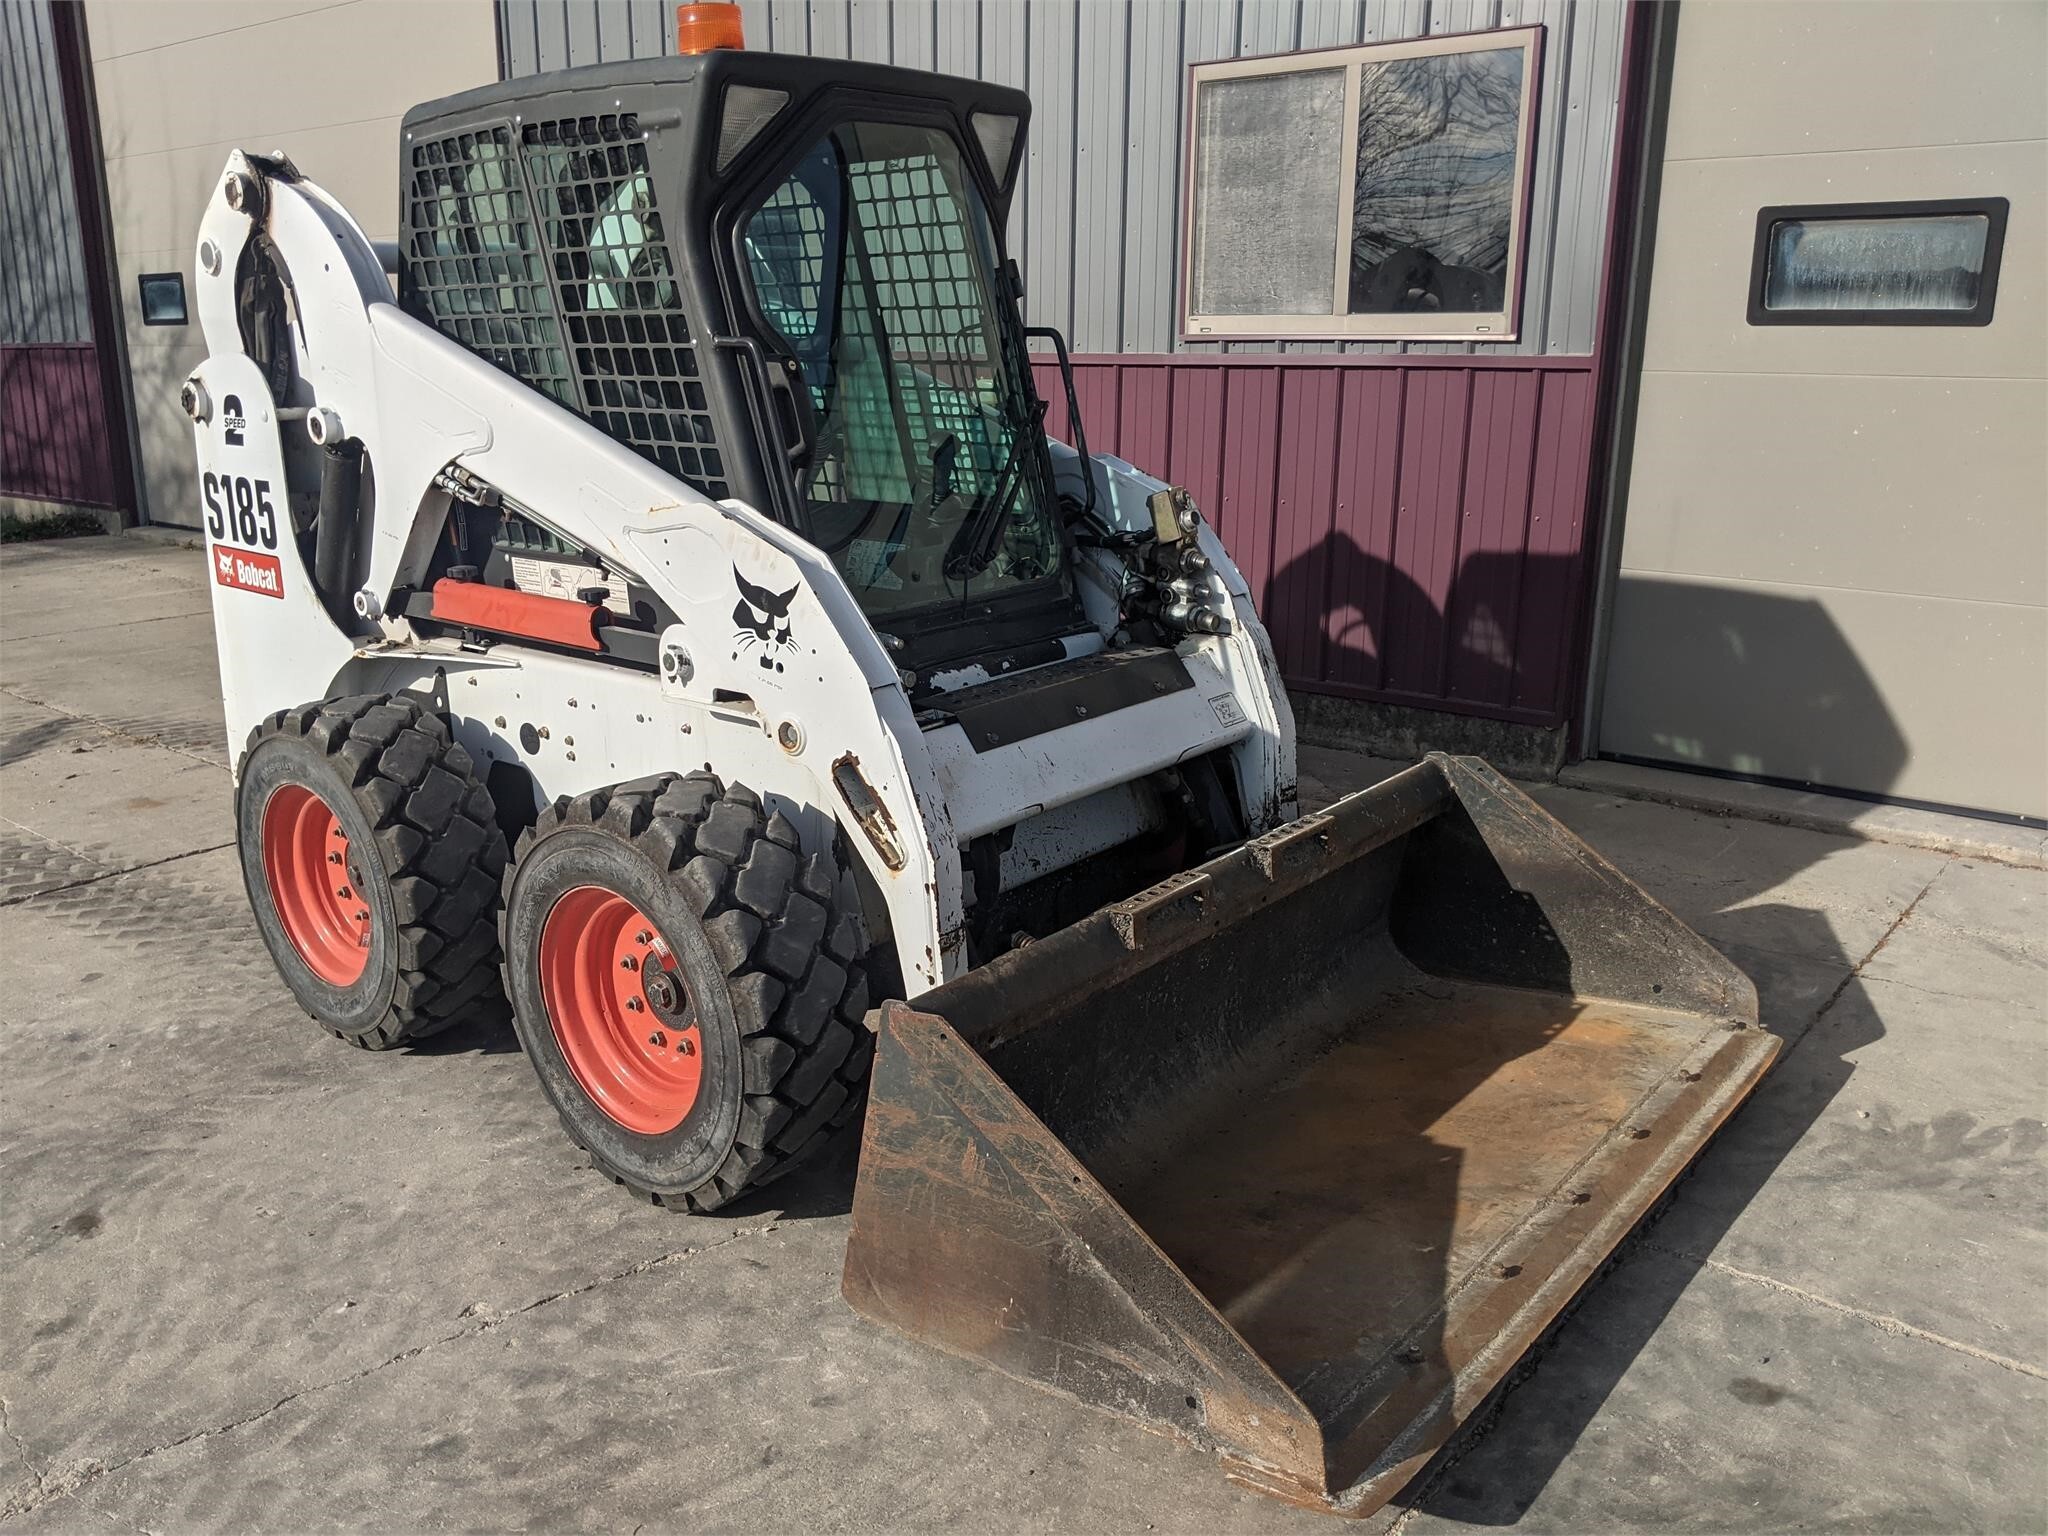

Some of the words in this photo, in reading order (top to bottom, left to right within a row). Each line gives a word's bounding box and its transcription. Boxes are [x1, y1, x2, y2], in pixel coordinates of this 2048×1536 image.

[224, 394, 244, 446] 2
[225, 417, 246, 429] SPEED
[204, 472, 277, 550] S185
[236, 559, 278, 592] Bobcat
